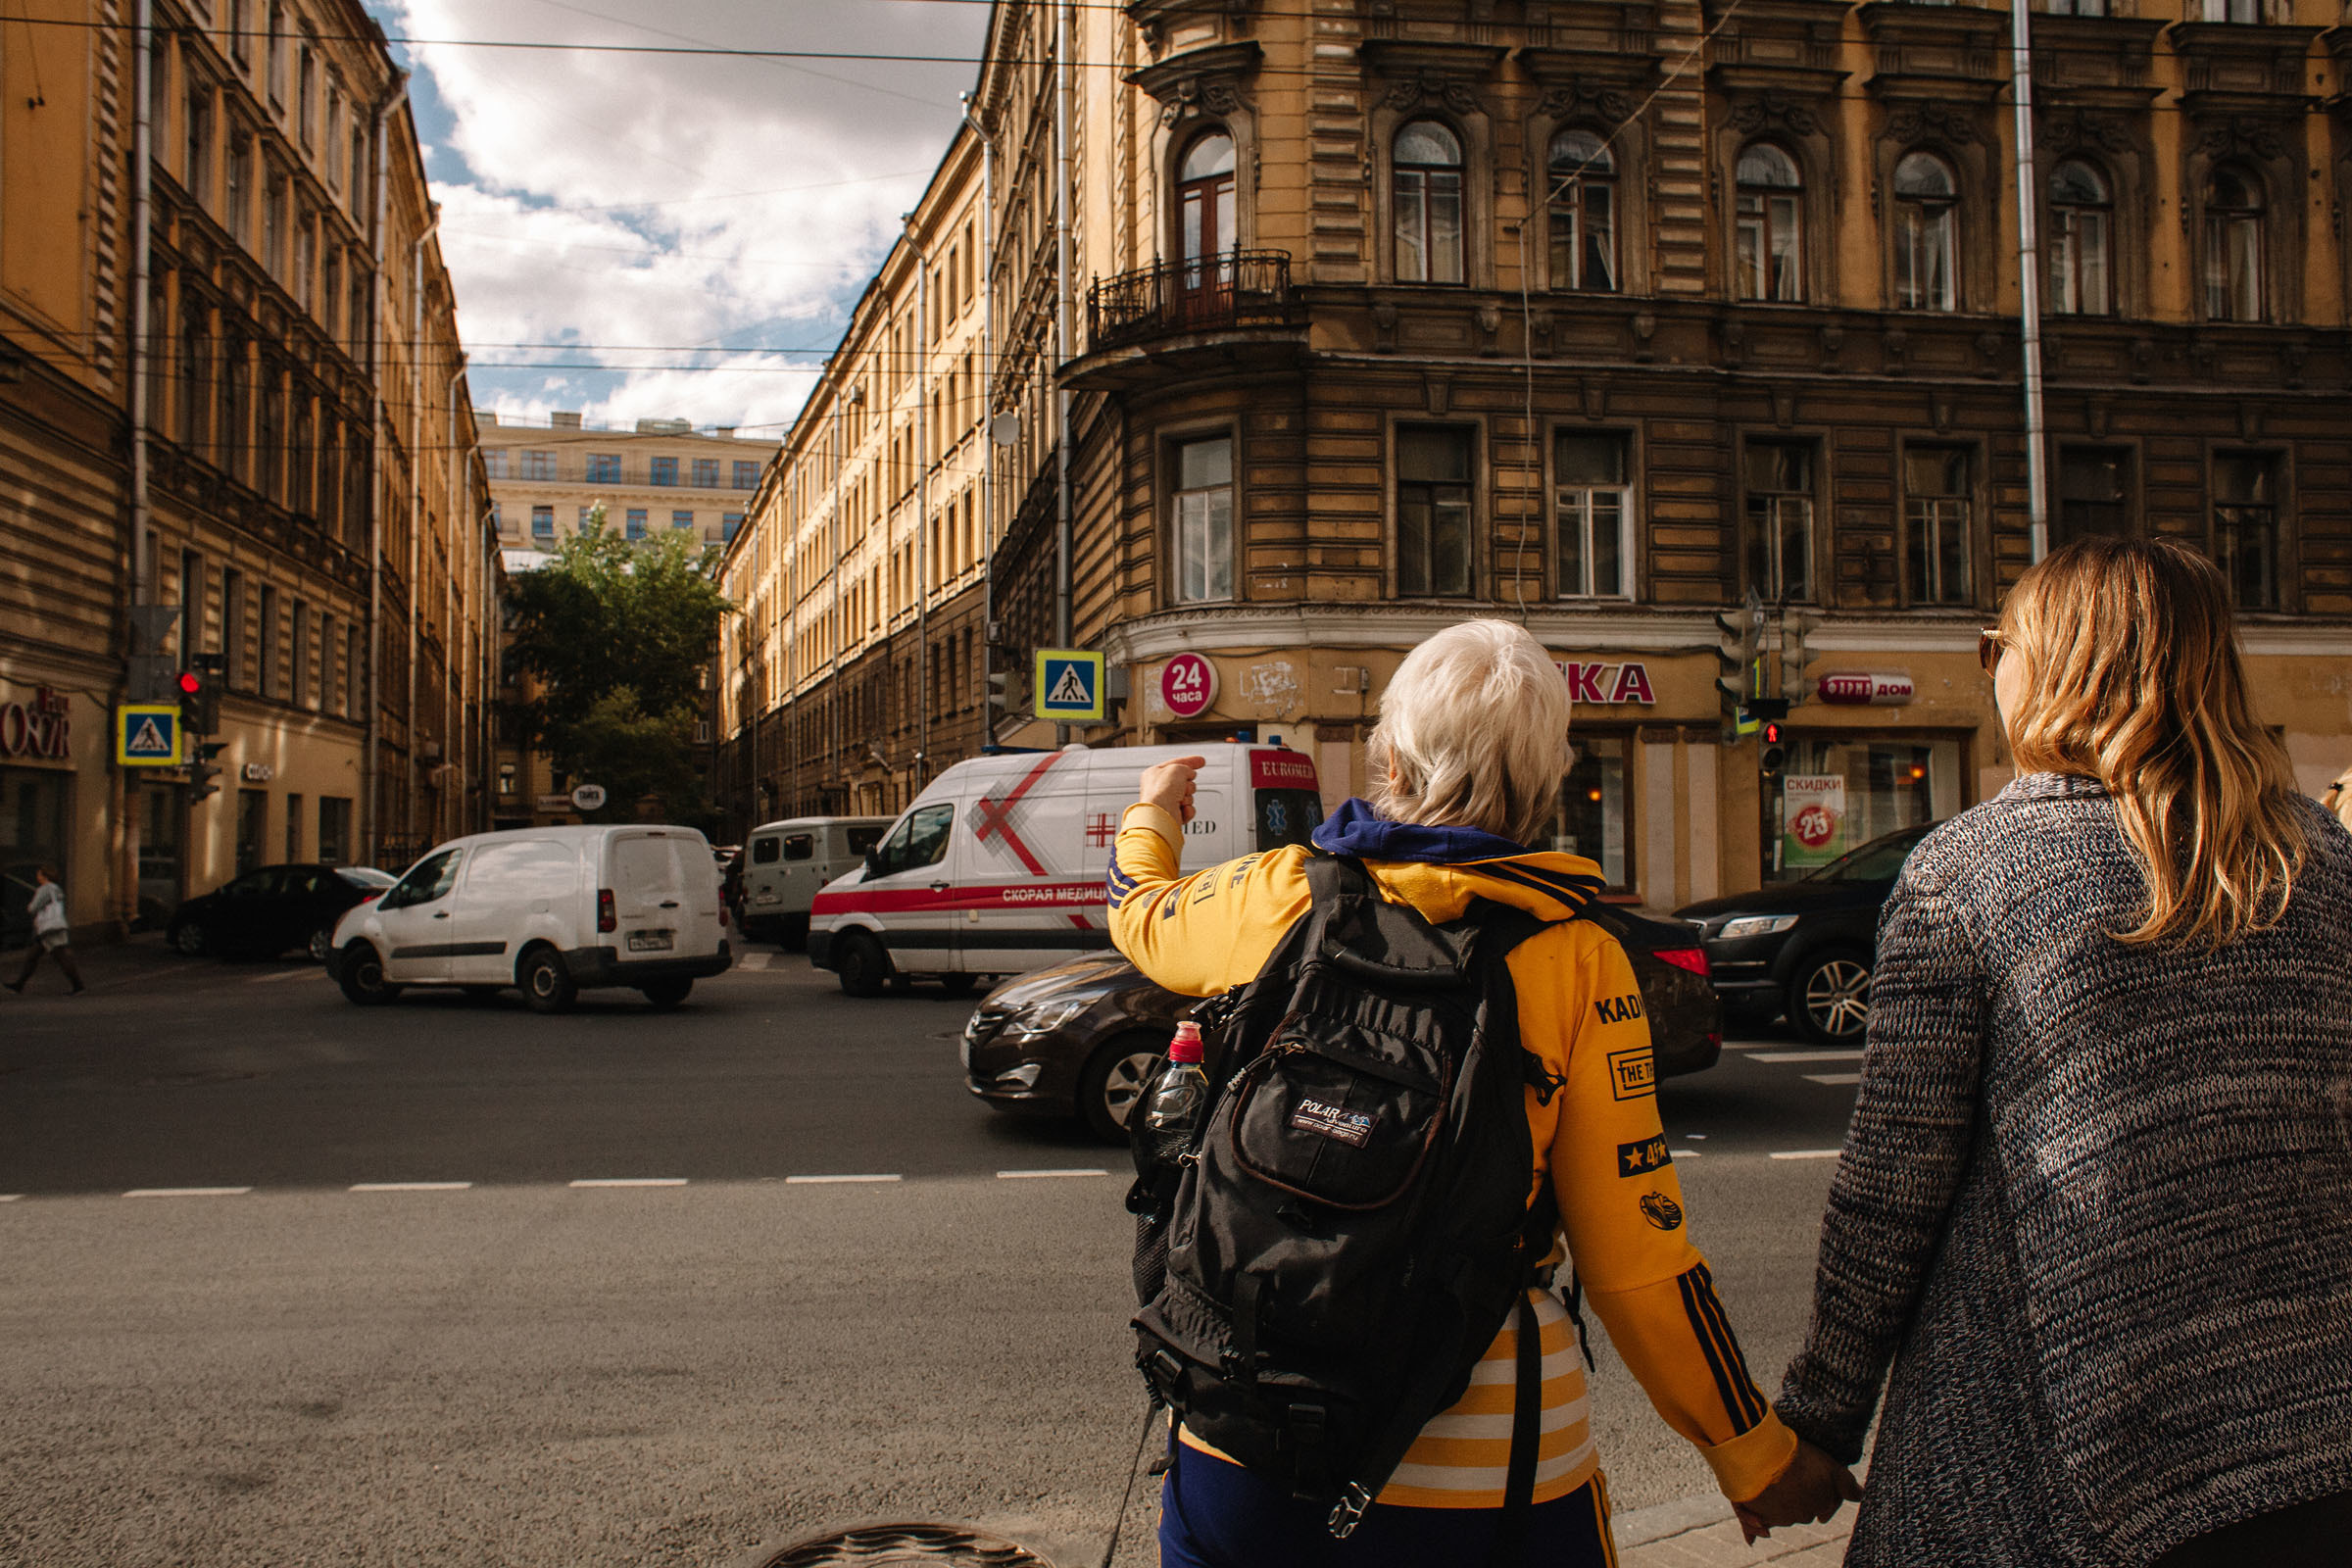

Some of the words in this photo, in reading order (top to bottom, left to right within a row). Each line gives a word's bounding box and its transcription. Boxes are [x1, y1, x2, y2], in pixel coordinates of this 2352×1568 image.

[1171, 662, 1202, 700] 24
[1555, 662, 1656, 704] КА
[1877, 684, 1912, 697] ДОМ
[1172, 690, 1202, 704] часа
[1261, 760, 1314, 779] EUROMED
[1787, 778, 1841, 792] СКИДКИ
[1003, 888, 1054, 902] СКОРАЯ
[1616, 1063, 1644, 1084] THE
[1298, 1099, 1341, 1119] POLAR
